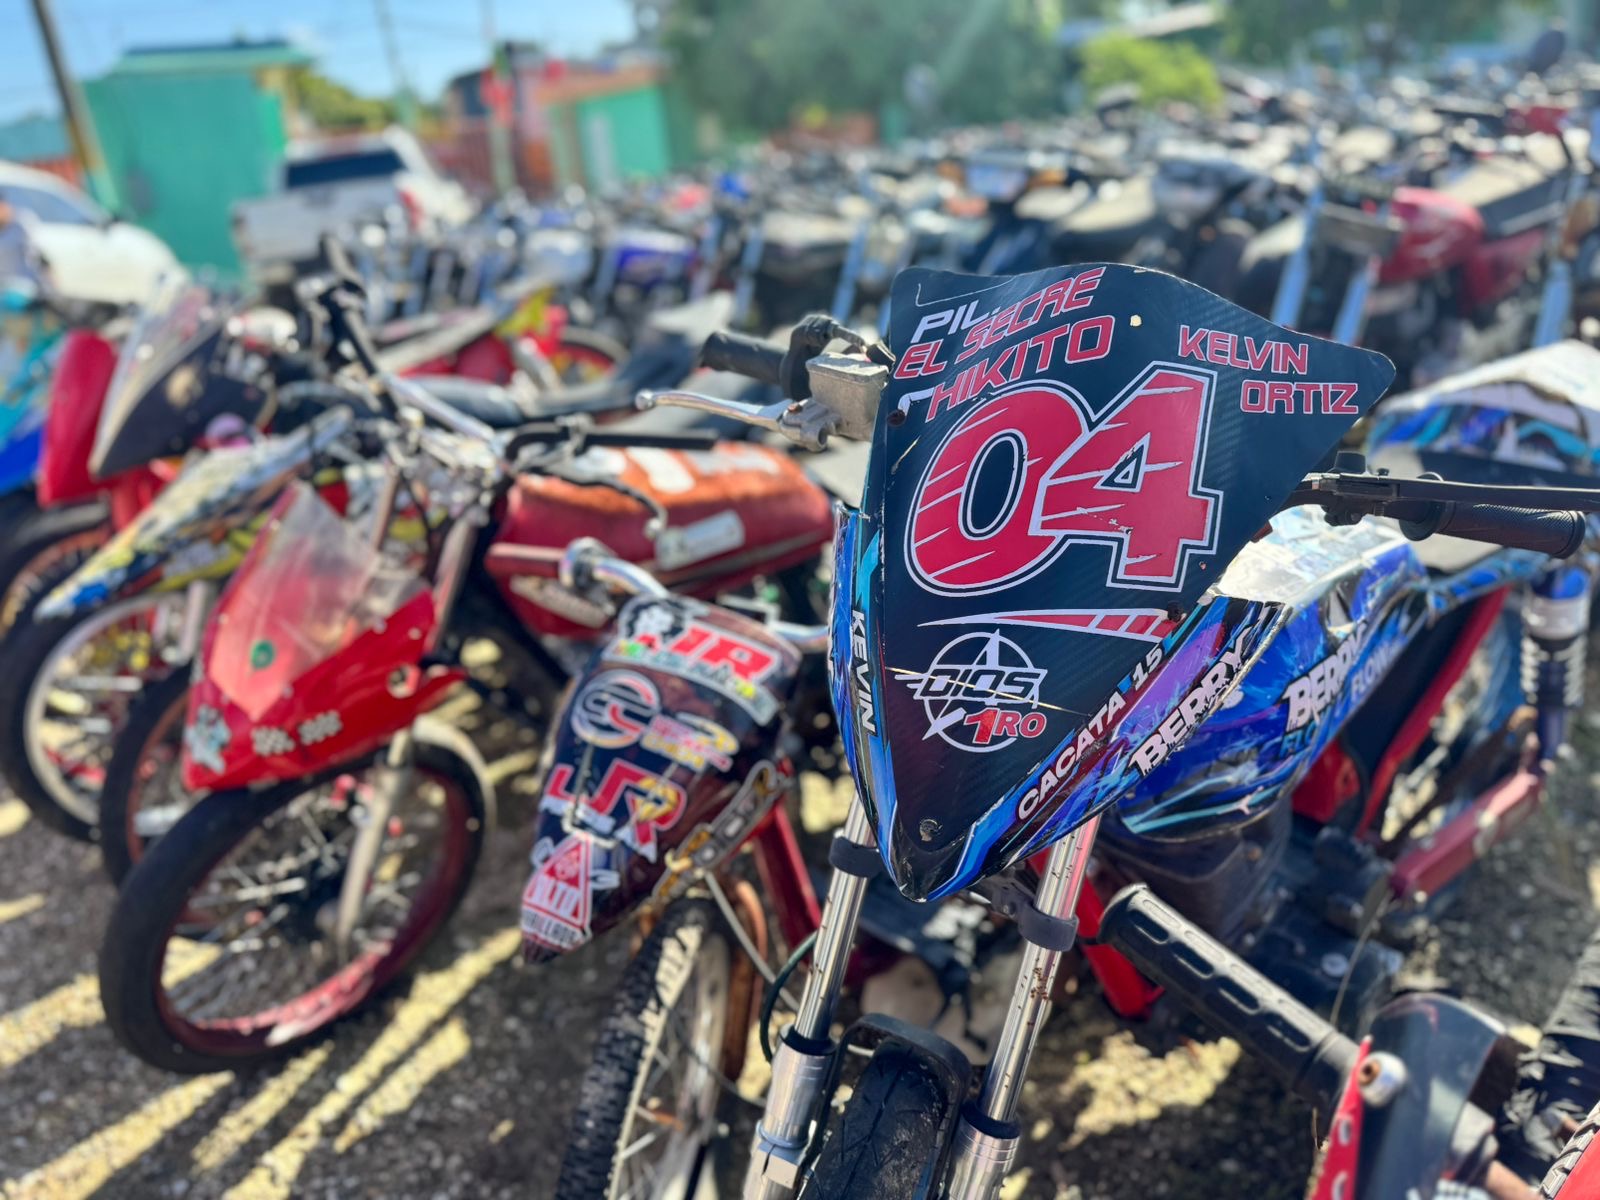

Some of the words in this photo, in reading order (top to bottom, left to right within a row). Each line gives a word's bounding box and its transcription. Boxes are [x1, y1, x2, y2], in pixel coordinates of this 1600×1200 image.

[893, 339, 948, 379] EL
[954, 266, 1107, 364] SECRE
[910, 299, 1001, 343] PIL
[1178, 324, 1309, 375] KELVIN
[1240, 379, 1359, 415] ORTIZ
[905, 361, 1224, 597] 04
[852, 609, 877, 734] KEVIN
[963, 707, 1048, 745] 1RO
[1128, 626, 1253, 776] BERRY
[1018, 692, 1127, 820] CACATA
[1132, 643, 1165, 691] 15
